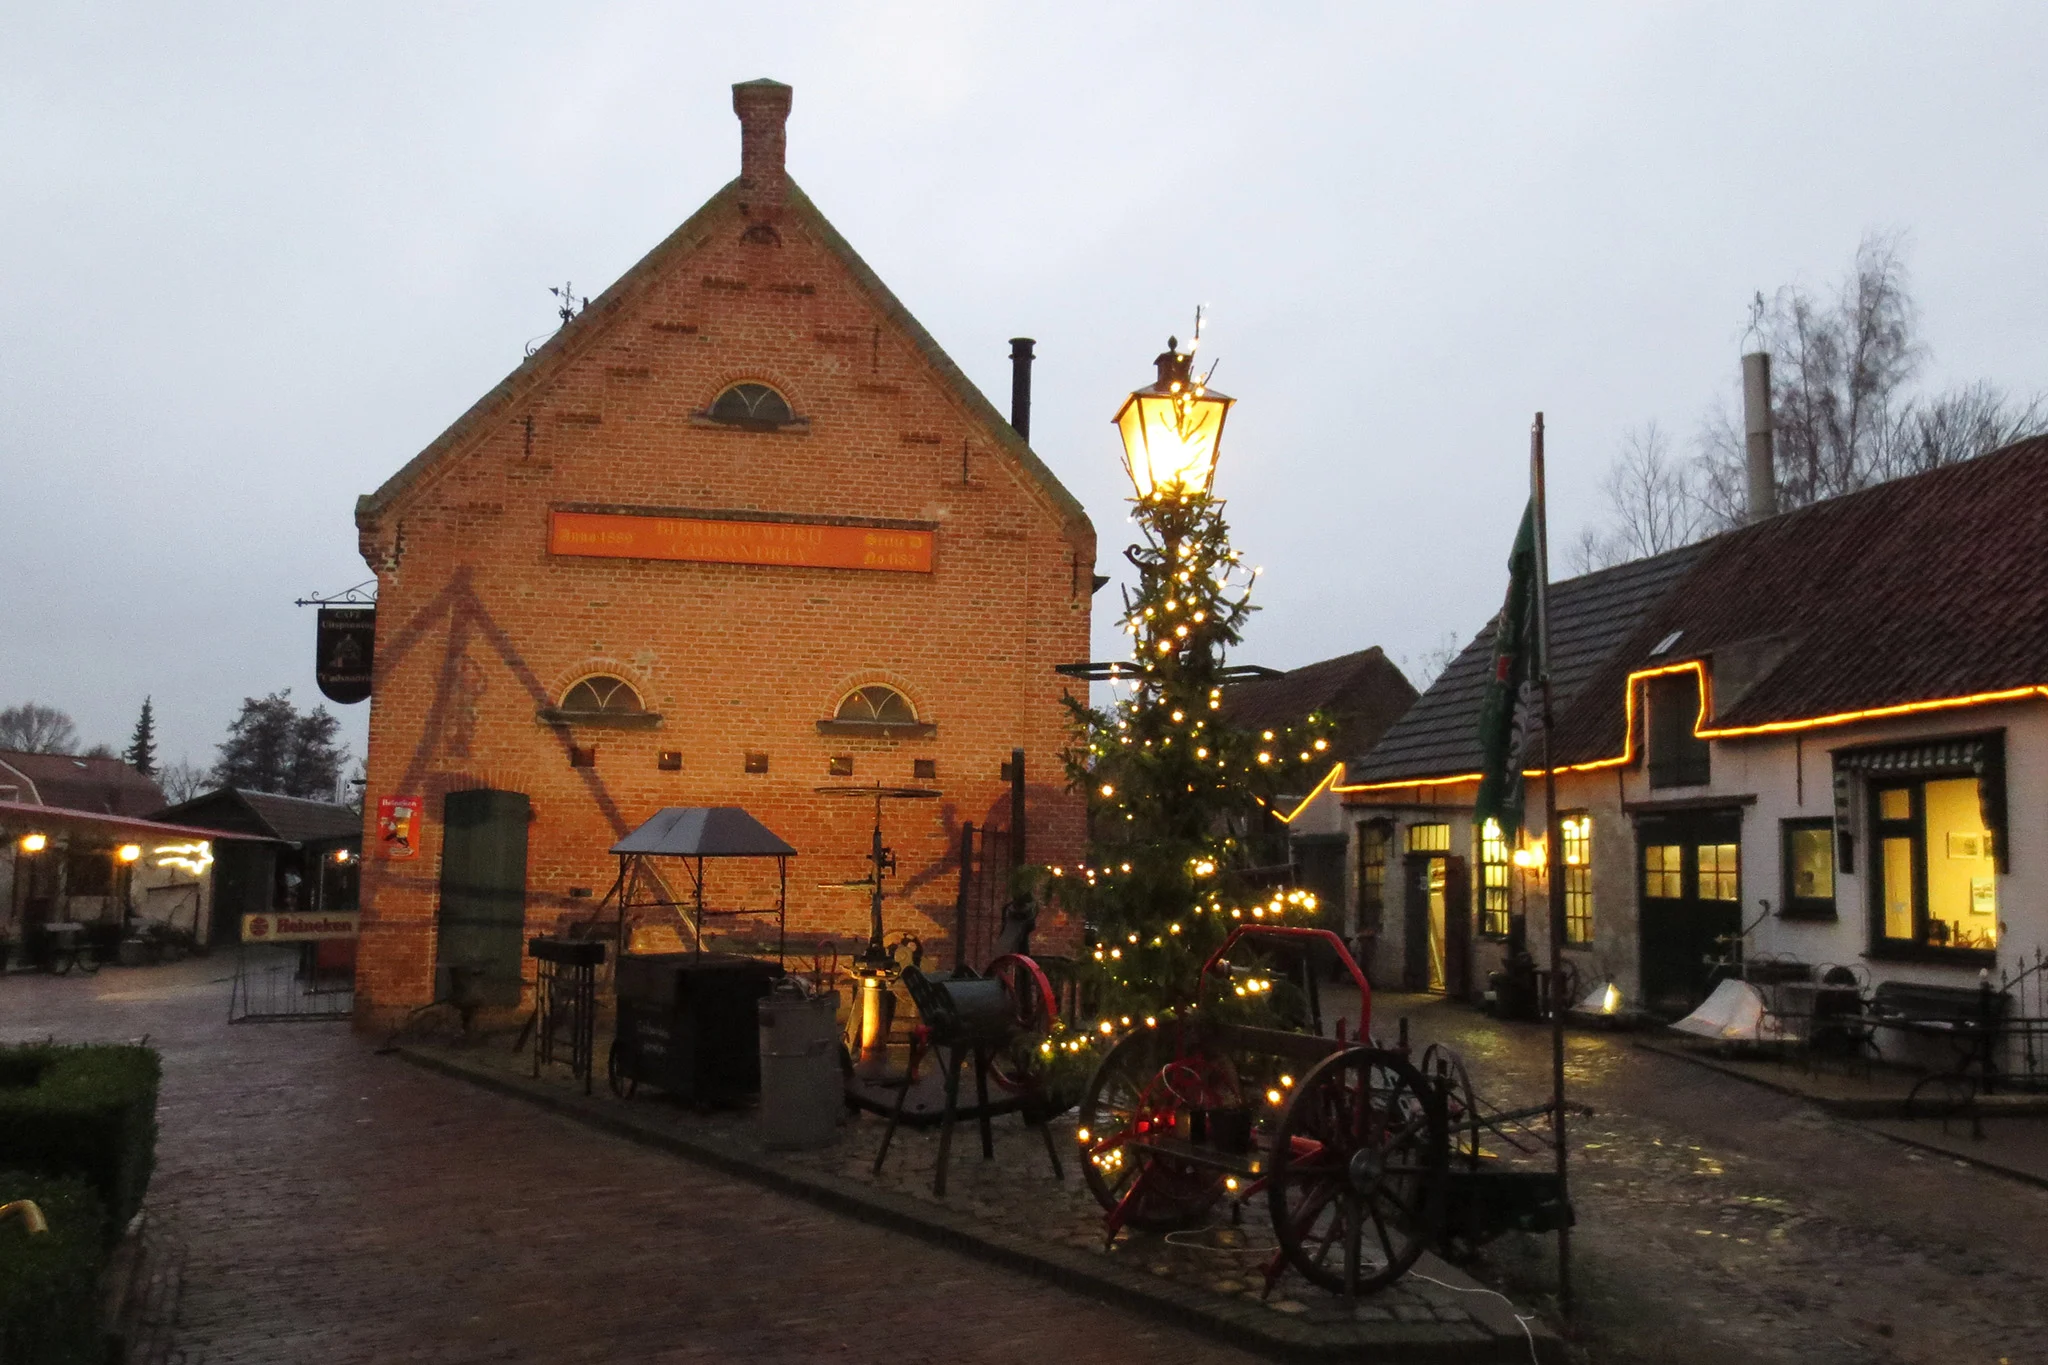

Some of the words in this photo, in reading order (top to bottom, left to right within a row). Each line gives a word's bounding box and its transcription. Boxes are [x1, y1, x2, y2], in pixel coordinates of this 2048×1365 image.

[656, 520, 823, 545] BIERBROUWERIJ
[382, 799, 417, 807] Heineken
[276, 917, 352, 933] Heineken
